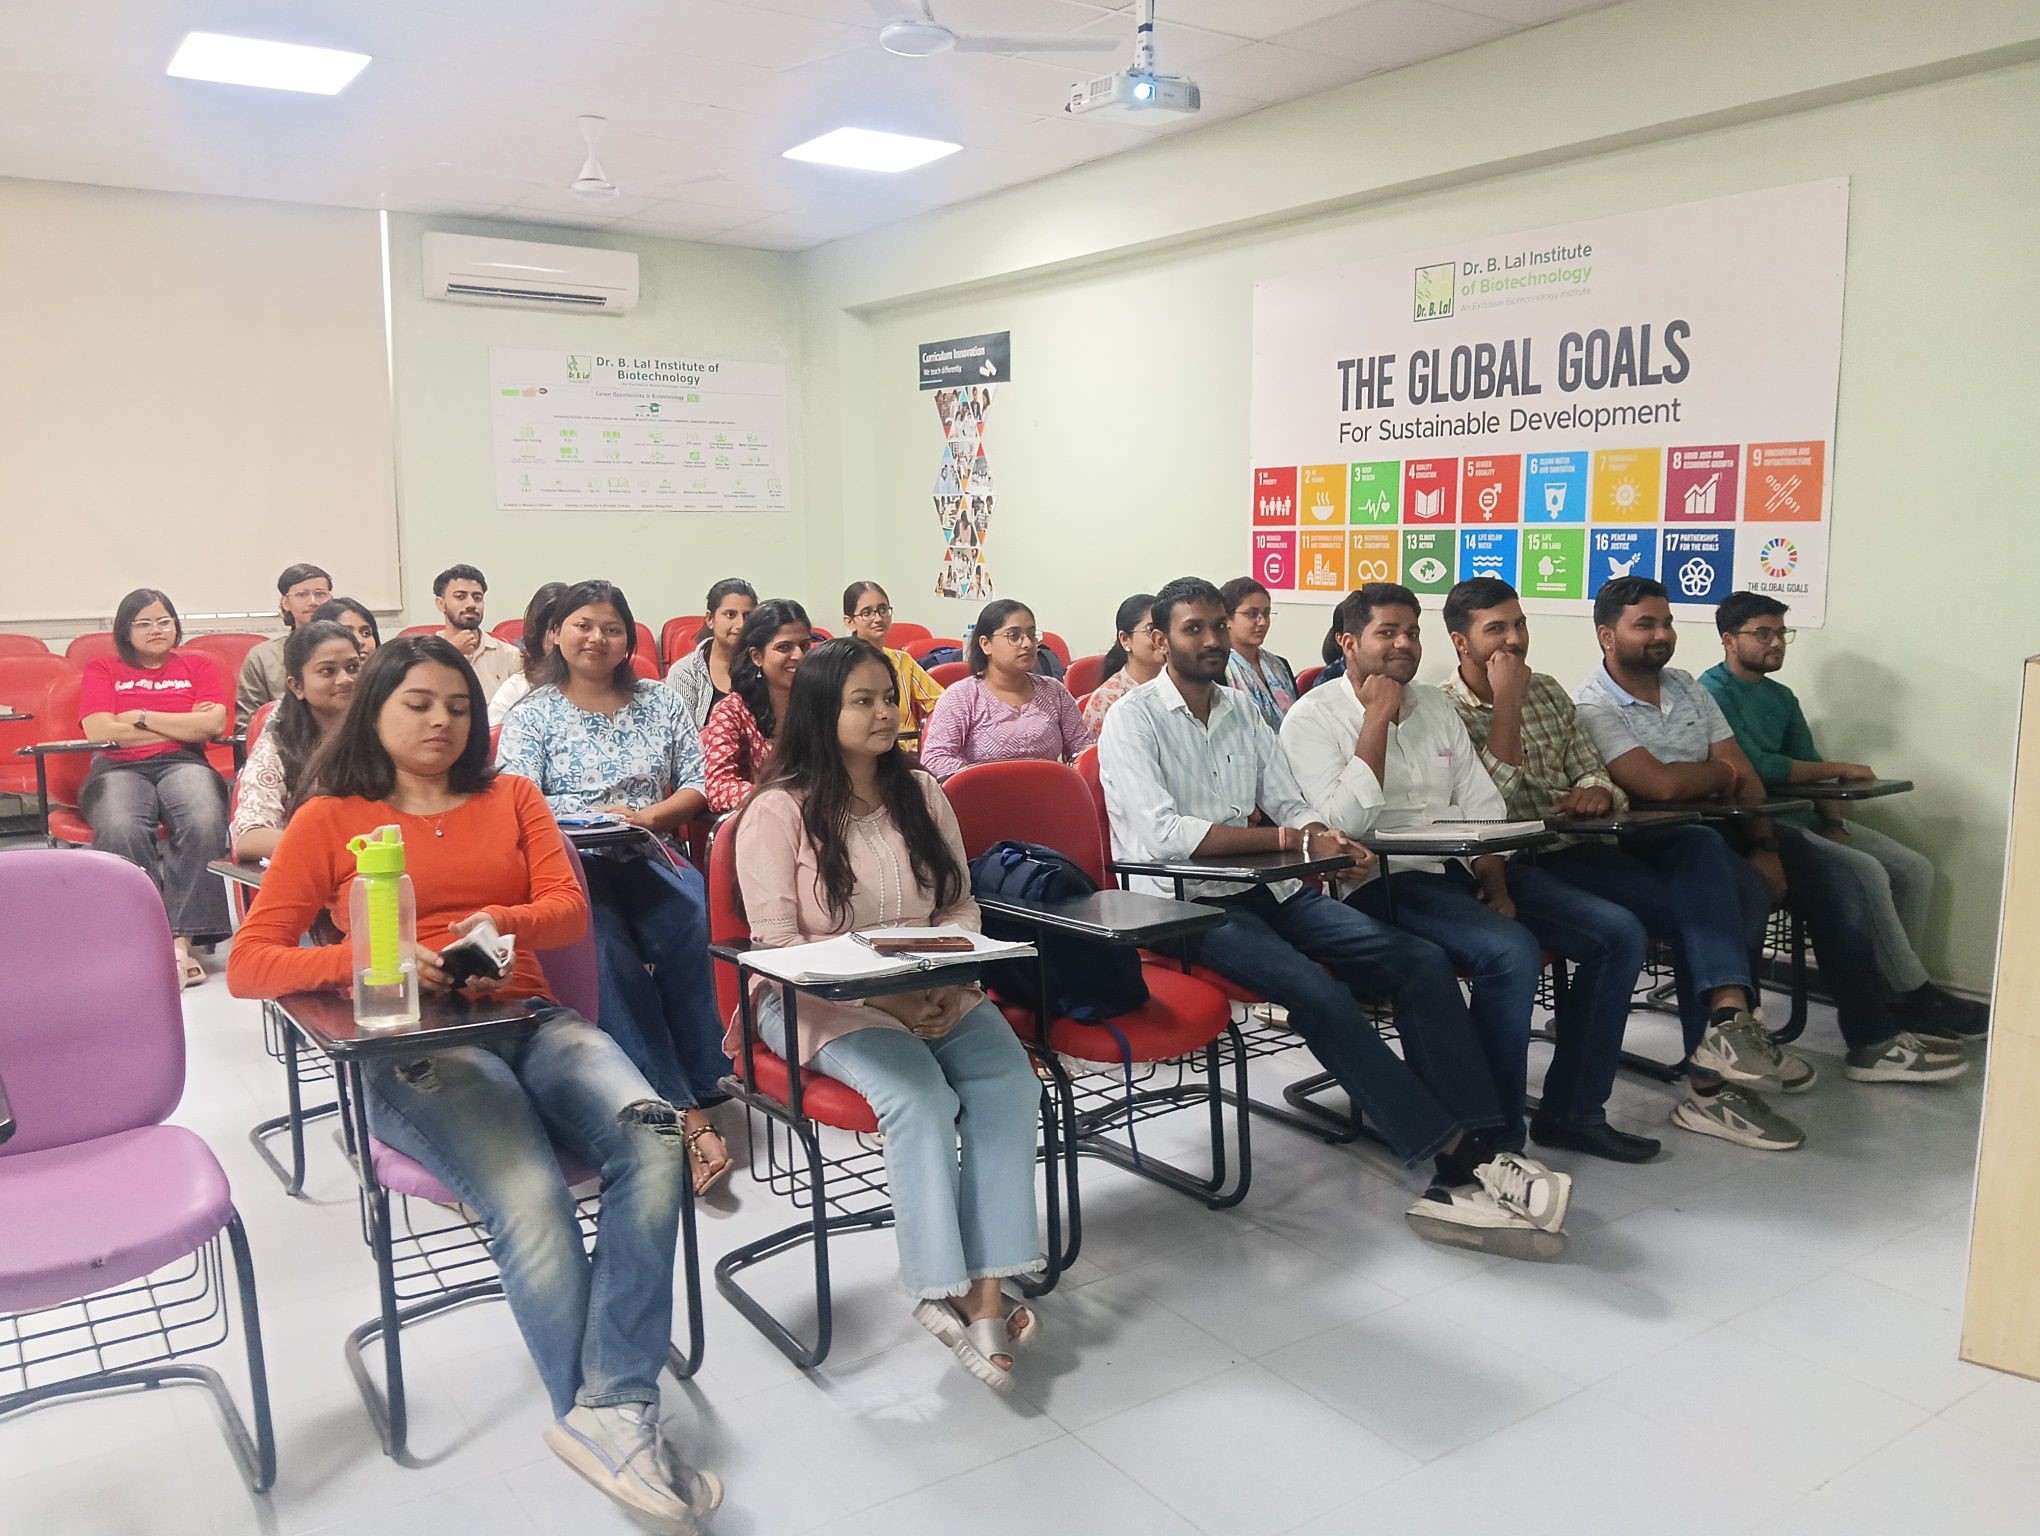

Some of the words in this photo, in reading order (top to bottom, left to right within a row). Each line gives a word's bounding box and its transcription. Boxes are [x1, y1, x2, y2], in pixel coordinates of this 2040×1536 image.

[1463, 262, 1483, 276] Dr.
[1487, 258, 1501, 272] B.
[1505, 252, 1526, 269] Lal
[1530, 244, 1593, 265] Institute
[1461, 283, 1476, 297] of
[1480, 266, 1593, 294] Biotechnology
[1416, 303, 1427, 318] Dr.
[1428, 302, 1437, 316] B.
[1439, 298, 1452, 315] Lal
[596, 356, 614, 367] Dr.
[618, 358, 630, 368] B.
[634, 359, 651, 369] Lal
[655, 359, 705, 372] Institute
[708, 363, 720, 373] of
[1337, 354, 1396, 411] THE
[1408, 337, 1542, 405] GLOBAL
[1557, 319, 1691, 393] GOALS
[617, 370, 700, 385] Biotechnology
[1339, 423, 1373, 443] For
[1378, 411, 1500, 441] Sustainable
[1510, 398, 1682, 436] Development
[1531, 457, 1538, 474] 6
[1673, 451, 1682, 470] 8
[1753, 449, 1762, 466] 9
[1305, 470, 1311, 484] 2
[1354, 466, 1361, 482] 3
[1408, 465, 1415, 479] 4
[1467, 461, 1474, 477] 5
[1258, 472, 1263, 486] 1
[1256, 535, 1266, 549] 10
[1302, 535, 1310, 549] 11
[1353, 535, 1362, 549] 12
[1407, 534, 1418, 549] 13
[1465, 534, 1476, 549] 14
[1527, 534, 1540, 550] 15
[1595, 533, 1609, 550] 16
[1665, 533, 1679, 551] 17
[1748, 582, 1759, 591] THE
[1760, 582, 1785, 592] GLOBAL
[1787, 583, 1809, 593] GOALS
